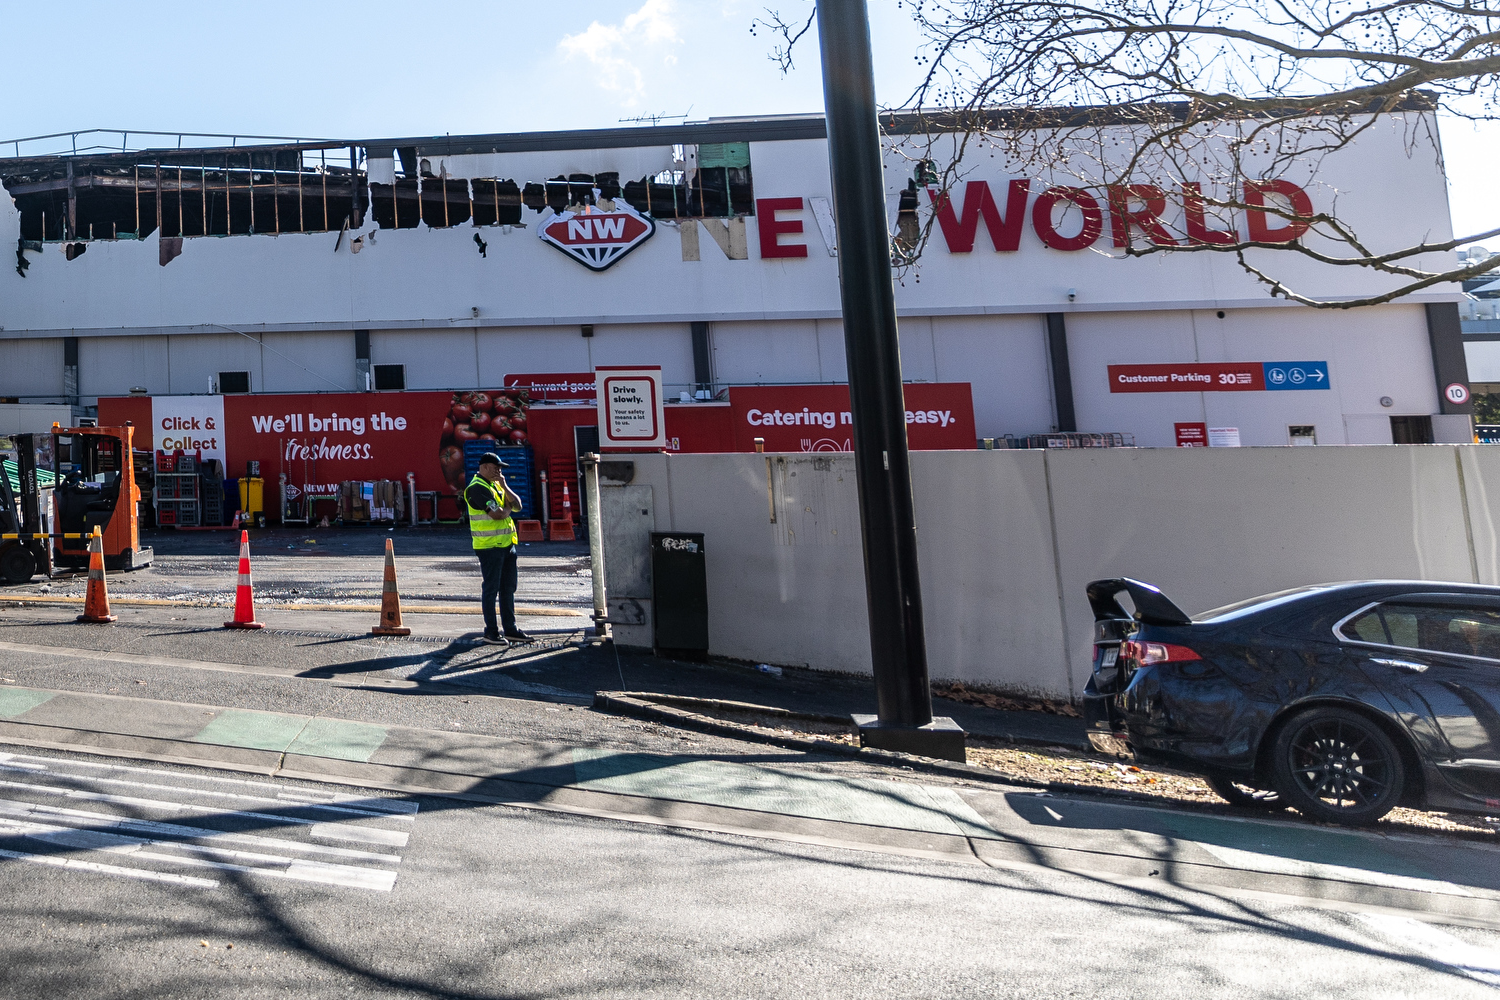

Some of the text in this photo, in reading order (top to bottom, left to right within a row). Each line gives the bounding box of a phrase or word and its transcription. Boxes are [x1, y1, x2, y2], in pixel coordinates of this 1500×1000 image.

[926, 178, 1313, 253] WORLD
[567, 218, 626, 240] NW
[1118, 373, 1236, 384] Customer Parking 30
[531, 380, 597, 393] Inward good
[614, 396, 643, 404] slowly.
[1450, 389, 1462, 398] 10
[161, 417, 216, 430] Click &
[252, 412, 407, 435] We’ll bring the
[747, 408, 836, 428] Catering
[905, 410, 955, 427] easy.
[162, 436, 217, 450] Collect
[285, 437, 374, 461] freshness.
[304, 484, 325, 492] NEW
